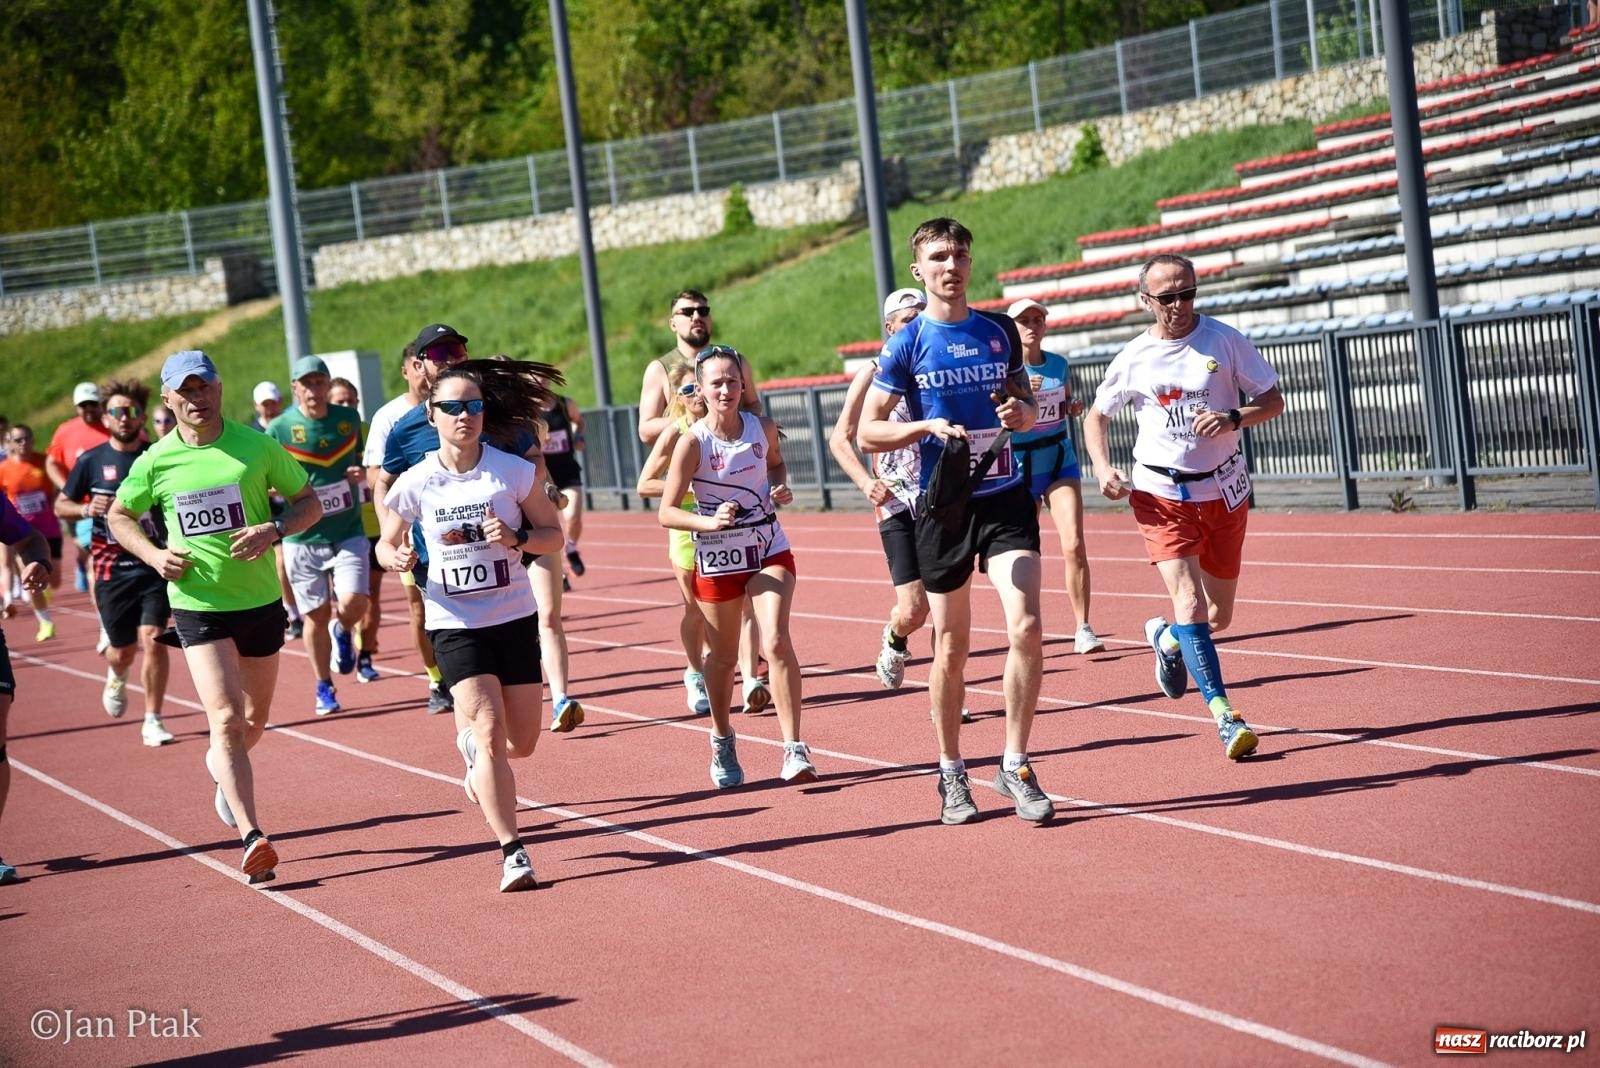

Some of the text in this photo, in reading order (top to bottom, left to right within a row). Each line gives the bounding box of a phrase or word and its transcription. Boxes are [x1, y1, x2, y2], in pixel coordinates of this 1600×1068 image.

[915, 362, 1009, 389] RUNNER
[1186, 388, 1210, 400] BIEG
[1166, 405, 1186, 428] XII
[1190, 401, 1209, 412] BEZ
[1172, 433, 1177, 441] 3
[1228, 473, 1247, 500] 149
[185, 507, 226, 530] 208
[436, 511, 486, 523] BIEG ULICZN
[706, 549, 742, 567] 230
[452, 564, 488, 587] 170
